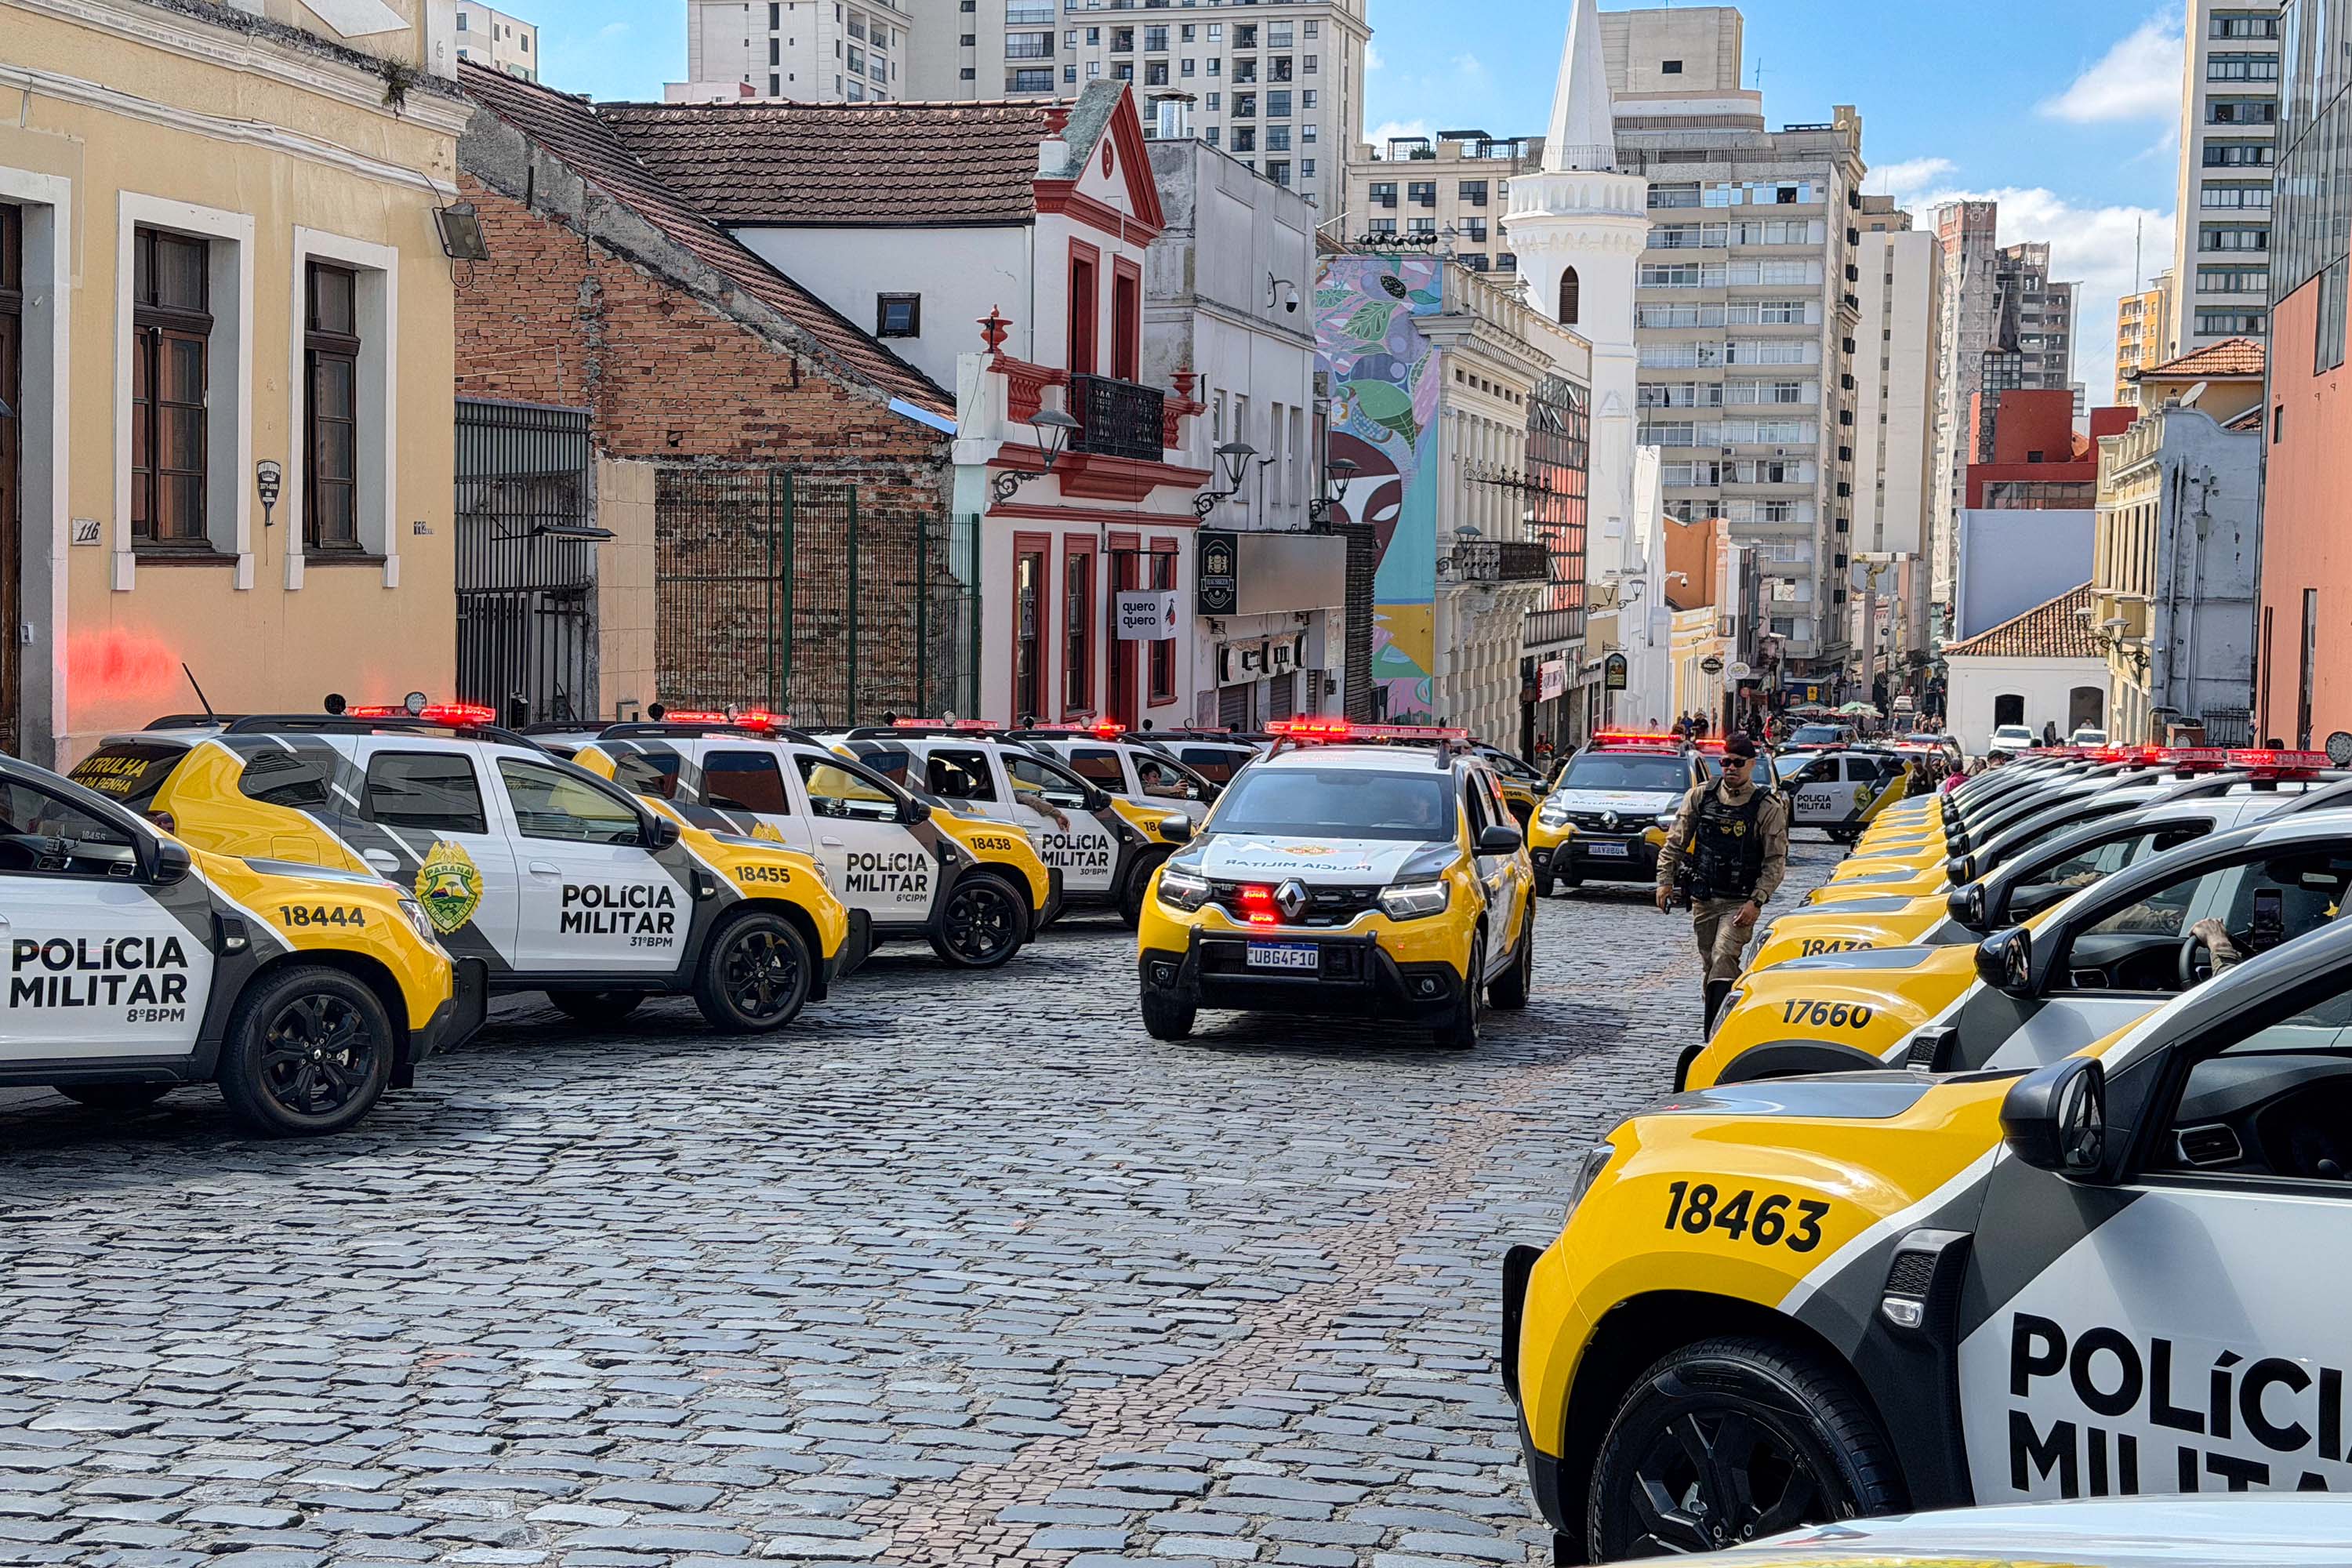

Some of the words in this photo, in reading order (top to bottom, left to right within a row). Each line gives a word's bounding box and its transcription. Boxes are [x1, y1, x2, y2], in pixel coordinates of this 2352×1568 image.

[76, 521, 100, 542] 116
[1123, 602, 1156, 615] quero
[1123, 616, 1156, 628] quero
[72, 757, 151, 778] PATRULHA
[96, 777, 132, 793] PENHA
[970, 837, 1012, 851] 18438
[1042, 833, 1109, 850] POLÍCIA
[846, 852, 928, 873] POLÍCIA
[1042, 851, 1109, 866] MILITAR
[735, 866, 791, 883] 18455
[845, 873, 928, 892] MILITAR
[562, 884, 676, 909] POLÍCIA
[279, 905, 365, 927] 18444
[451, 896, 474, 924] MILITAR
[561, 910, 675, 935] MILITAR
[12, 936, 188, 971] POLÍCIA
[1254, 949, 1316, 966] UBG4F10
[9, 973, 187, 1008] MILITAR
[1783, 998, 1872, 1029] 17660
[1664, 1181, 1831, 1253] 18463
[2010, 1312, 2352, 1464] POLÍCI
[2009, 1409, 2330, 1500] MILIT
